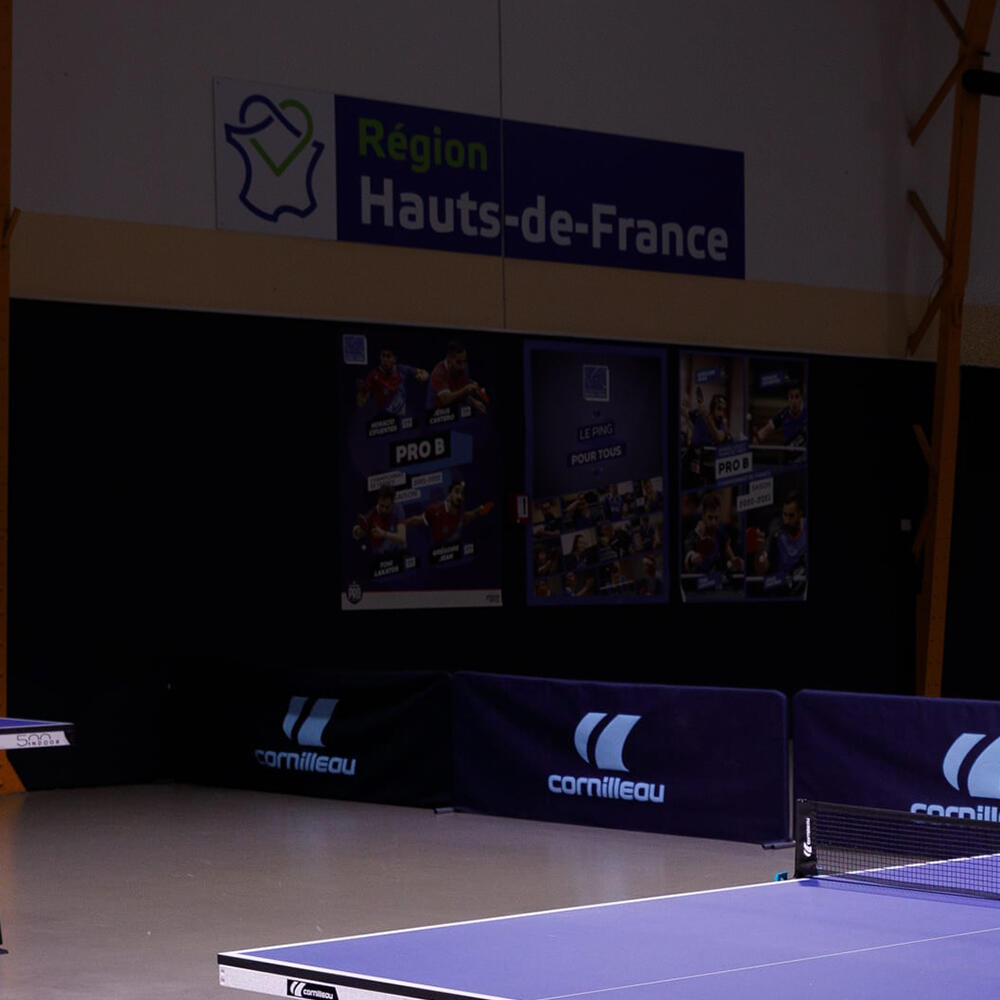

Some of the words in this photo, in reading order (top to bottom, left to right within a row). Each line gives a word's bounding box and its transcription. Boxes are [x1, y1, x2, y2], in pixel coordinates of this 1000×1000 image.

[357, 117, 488, 174] Région
[360, 175, 730, 262] Hauts-de-France
[579, 427, 591, 440] LE
[395, 441, 431, 464] PRO
[433, 437, 445, 457] B
[571, 451, 597, 465] POUR
[598, 445, 622, 460] TOUS
[719, 459, 740, 475] PRO
[743, 457, 749, 469] B
[255, 749, 357, 776] cornilleau
[547, 773, 666, 804] cornilleau
[303, 988, 334, 1000] cornilleau
